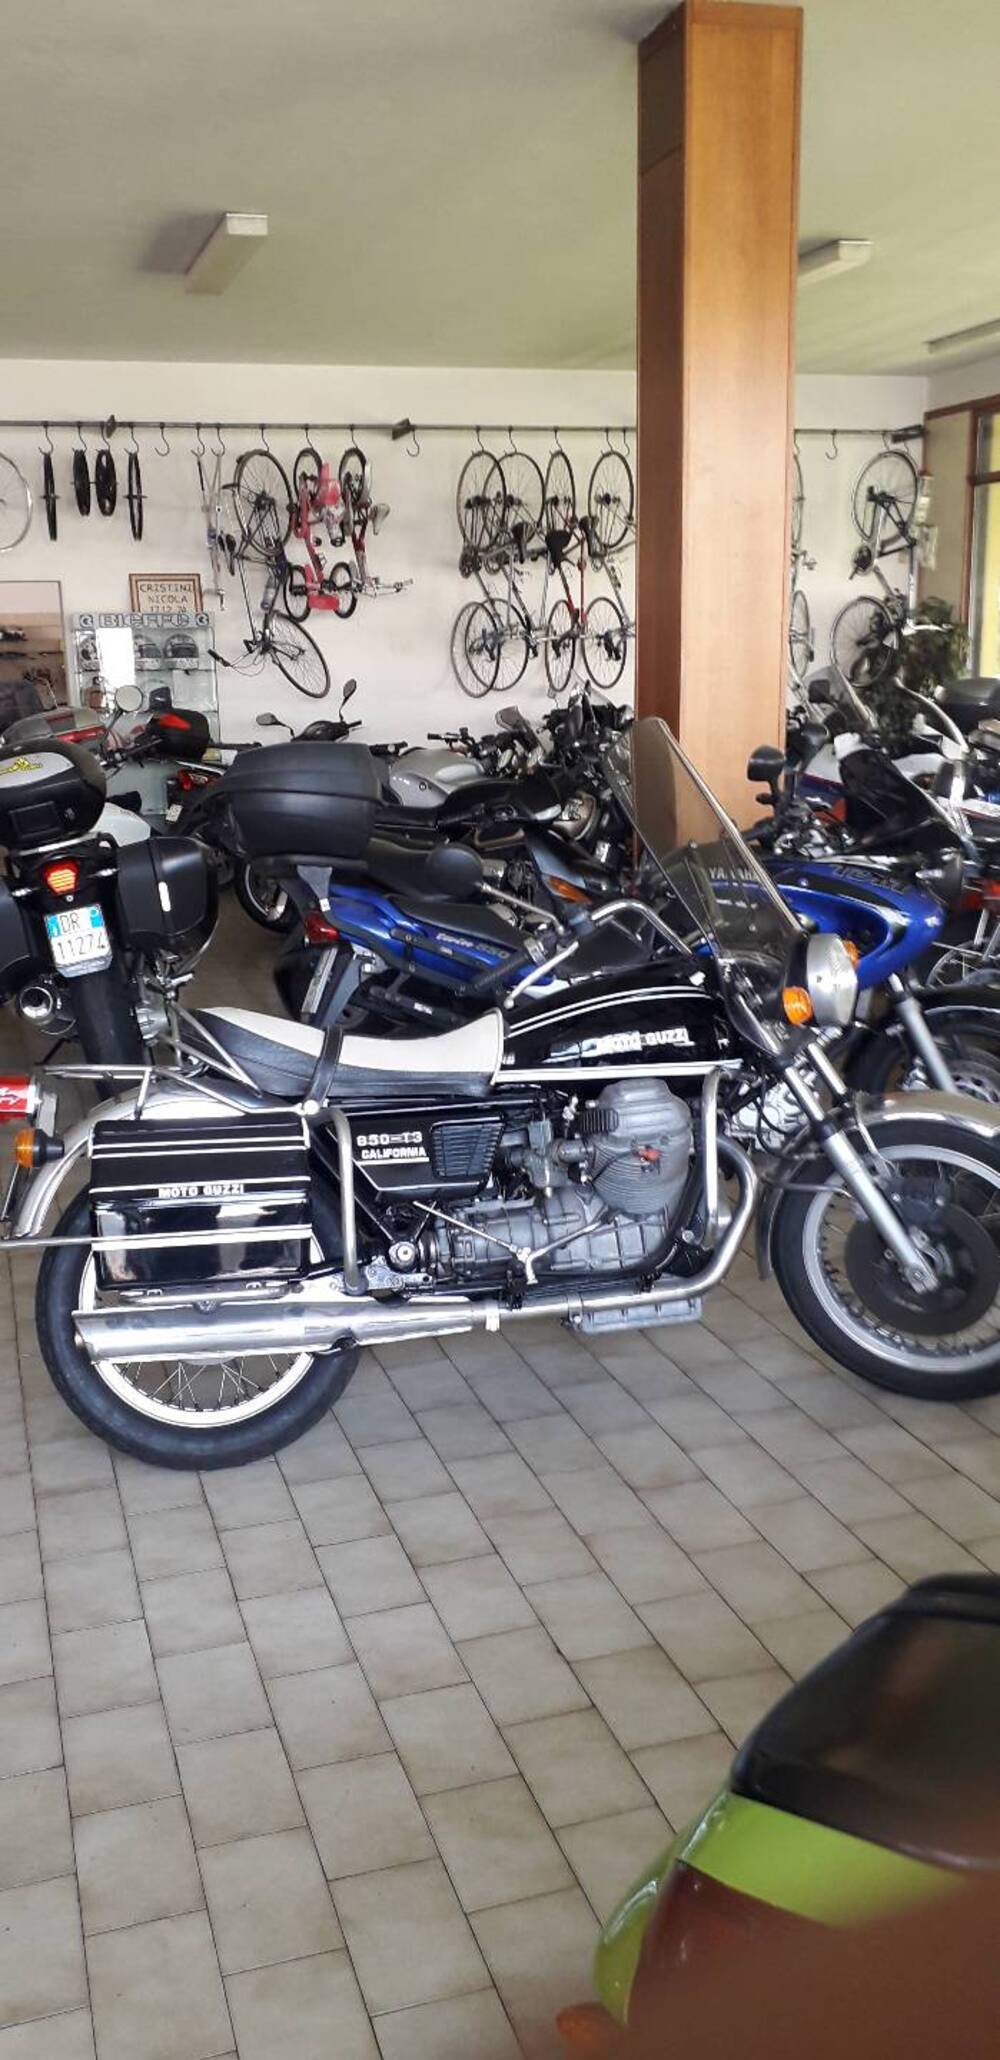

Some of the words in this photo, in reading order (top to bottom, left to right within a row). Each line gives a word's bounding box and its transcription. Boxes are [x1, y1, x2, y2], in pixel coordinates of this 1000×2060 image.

[139, 583, 192, 593] CRISTINI
[148, 594, 188, 604] NICOLA
[60, 912, 80, 933] DR
[645, 1028, 690, 1046] GUZZI
[361, 1146, 427, 1160] CALIFORNIA
[158, 1185, 199, 1198] MOTO
[202, 1183, 245, 1196] GUZZI
